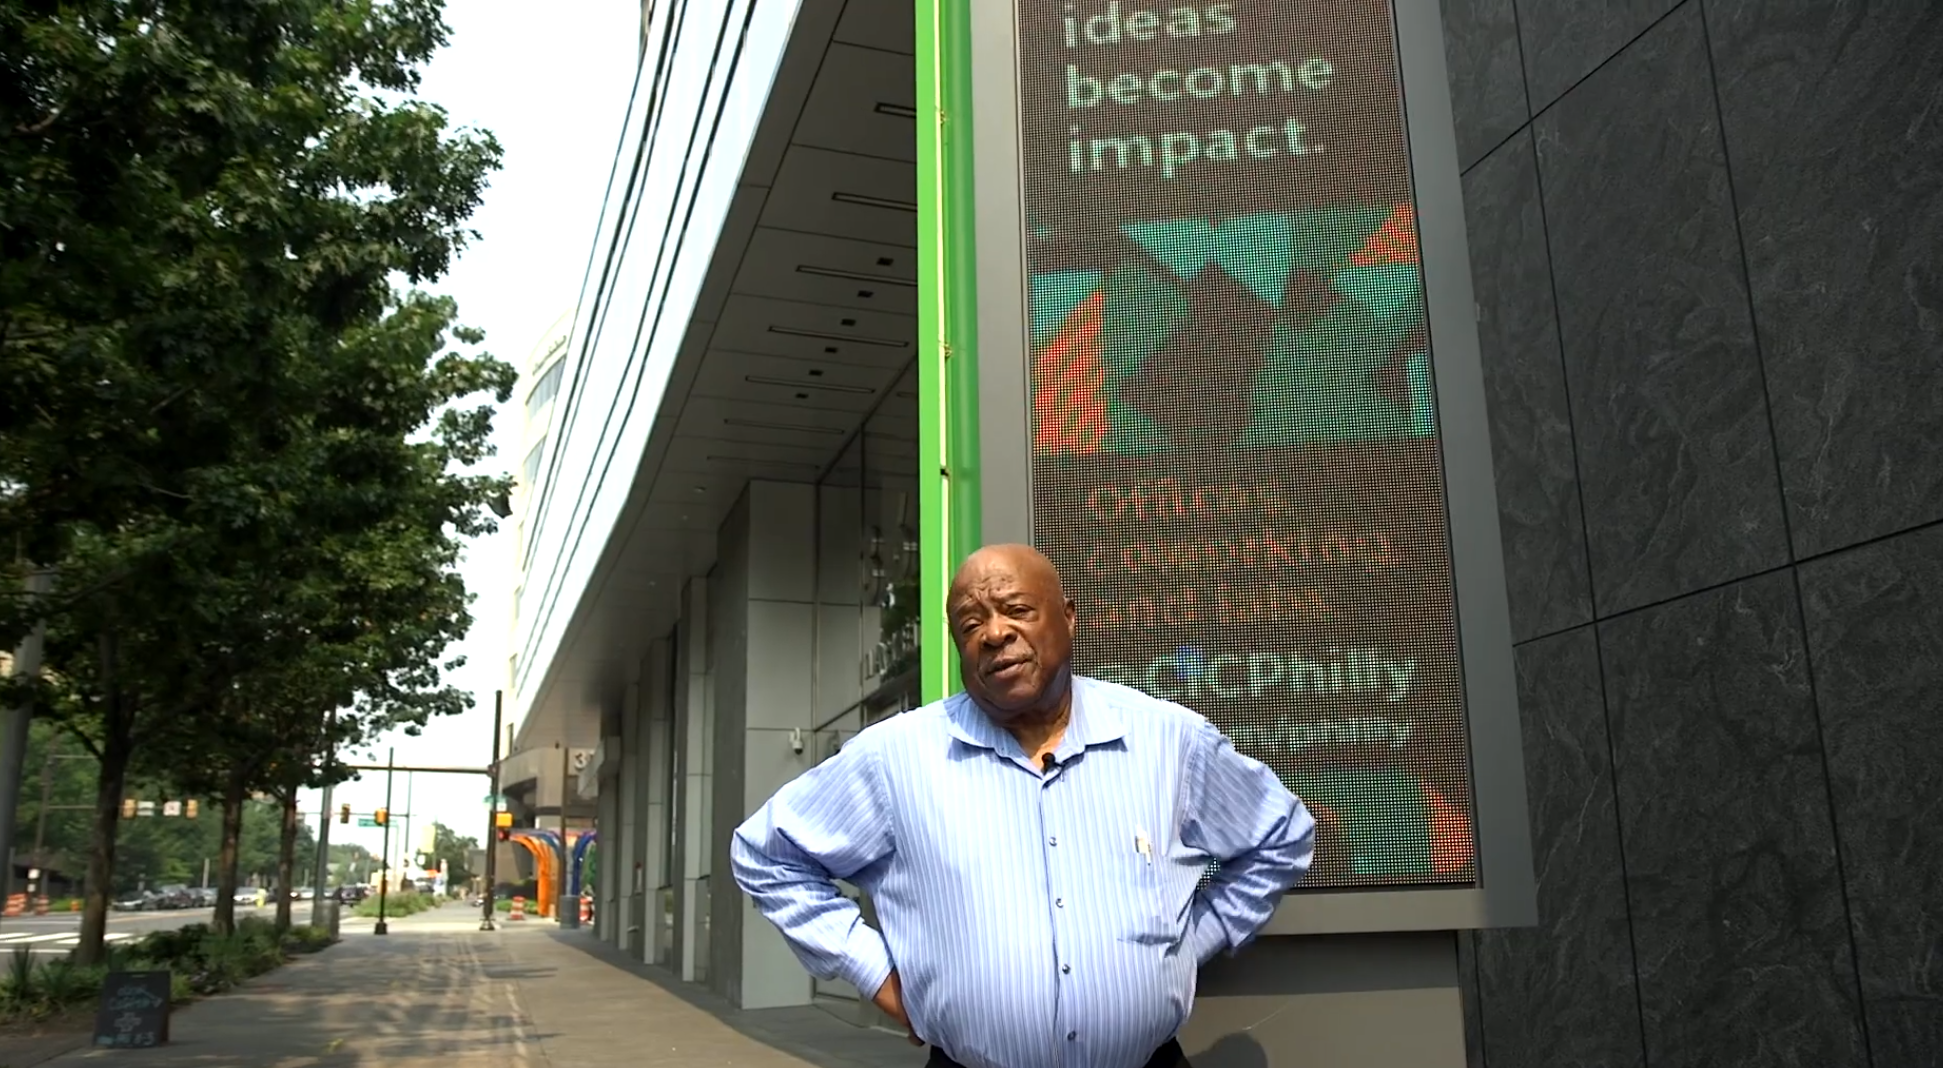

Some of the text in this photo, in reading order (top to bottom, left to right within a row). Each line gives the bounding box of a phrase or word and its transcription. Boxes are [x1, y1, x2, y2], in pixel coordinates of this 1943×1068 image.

[1063, 0, 1238, 48] ideas
[1065, 56, 1334, 109] become
[1068, 115, 1327, 180] impact.
[1089, 586, 1197, 631] and
